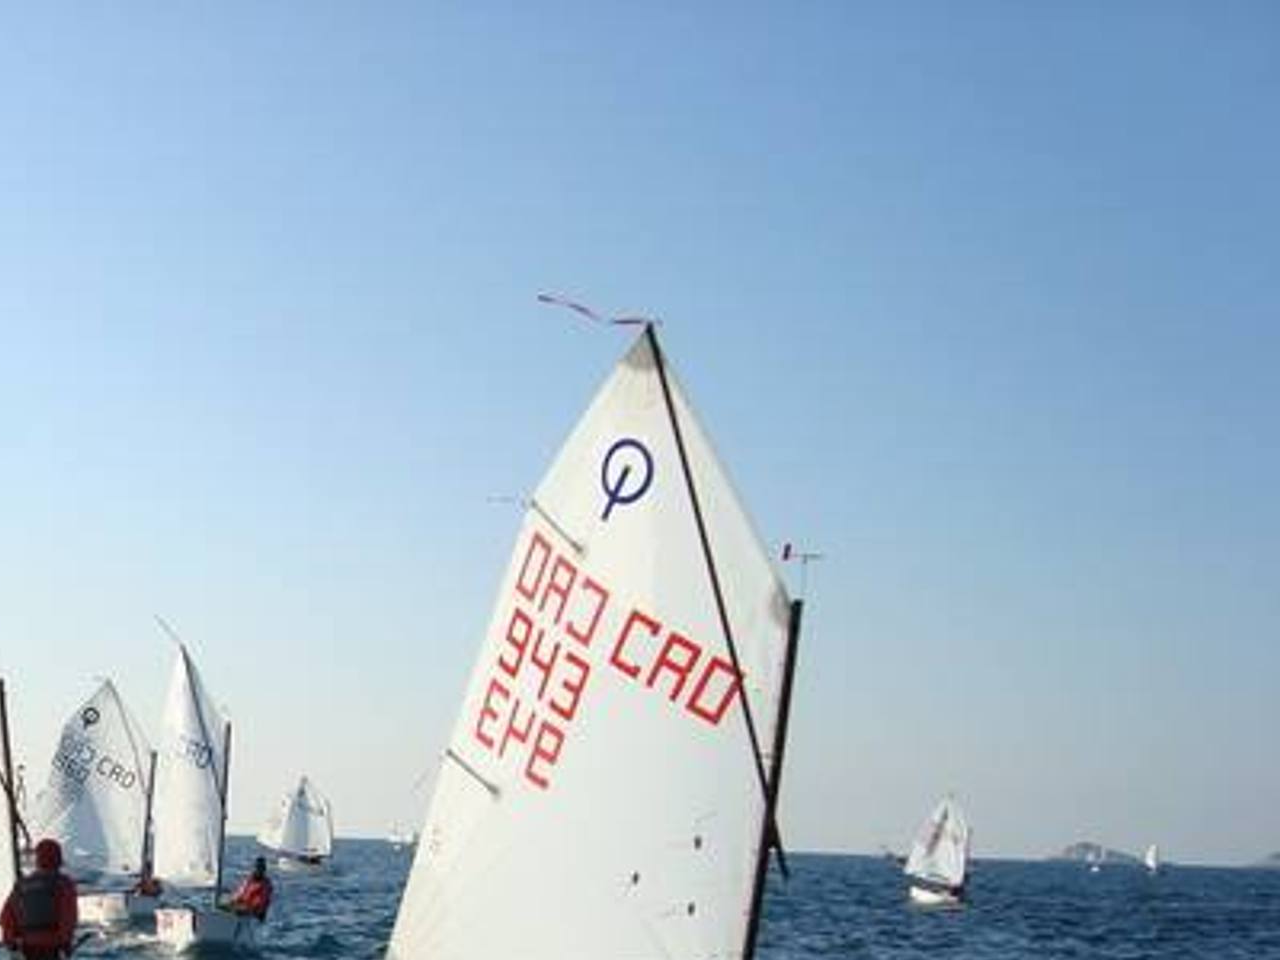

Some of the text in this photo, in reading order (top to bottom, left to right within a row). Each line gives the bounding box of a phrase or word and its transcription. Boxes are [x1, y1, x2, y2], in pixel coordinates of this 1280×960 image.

[499, 607, 591, 720] 943
[609, 610, 746, 725] CRO
[96, 755, 136, 788] CRO
